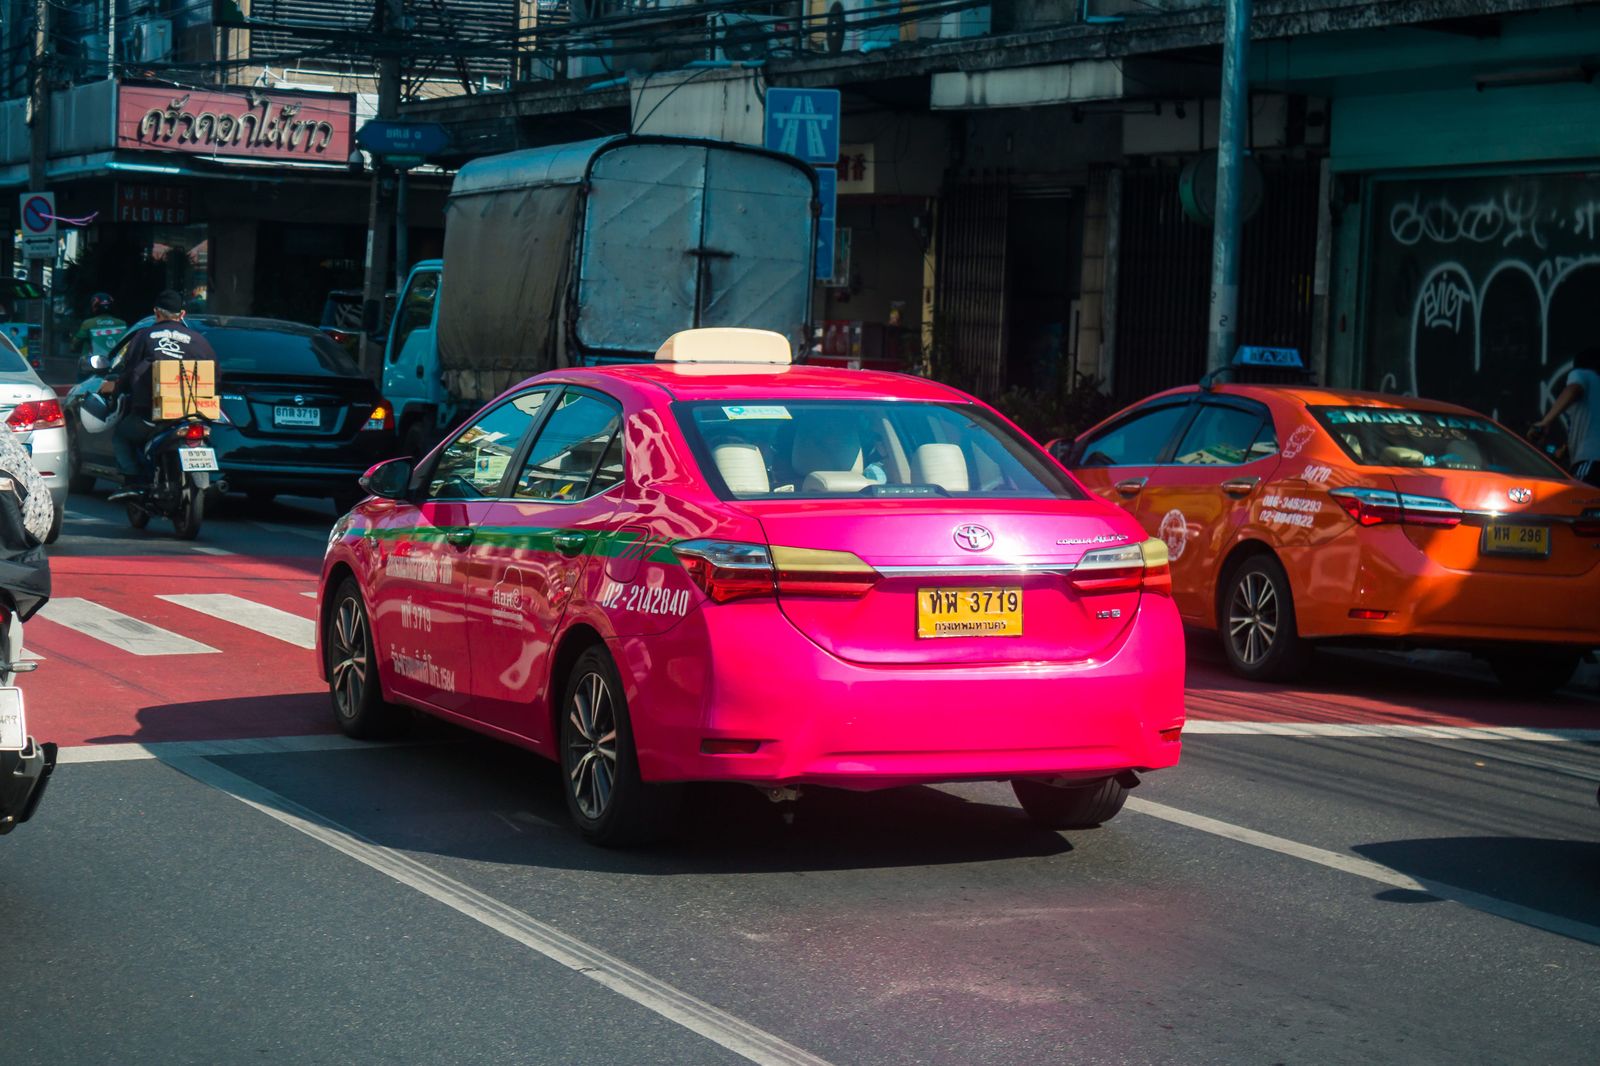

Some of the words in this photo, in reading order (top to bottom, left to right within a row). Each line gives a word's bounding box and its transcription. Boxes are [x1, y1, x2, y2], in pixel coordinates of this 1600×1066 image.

[140, 90, 333, 150] ครัวดอกไม้ขาว
[123, 184, 185, 204] WHITE
[122, 206, 185, 223] FLOWER
[196, 400, 217, 408] NSK
[296, 408, 319, 419] 3719
[1326, 411, 1422, 425] SMART
[1520, 528, 1541, 543] 296
[602, 582, 690, 617] 02-2142840
[970, 590, 1018, 613] 3719
[412, 605, 431, 633] 3719
[935, 621, 1006, 634] กรุงเทพมหานคร
